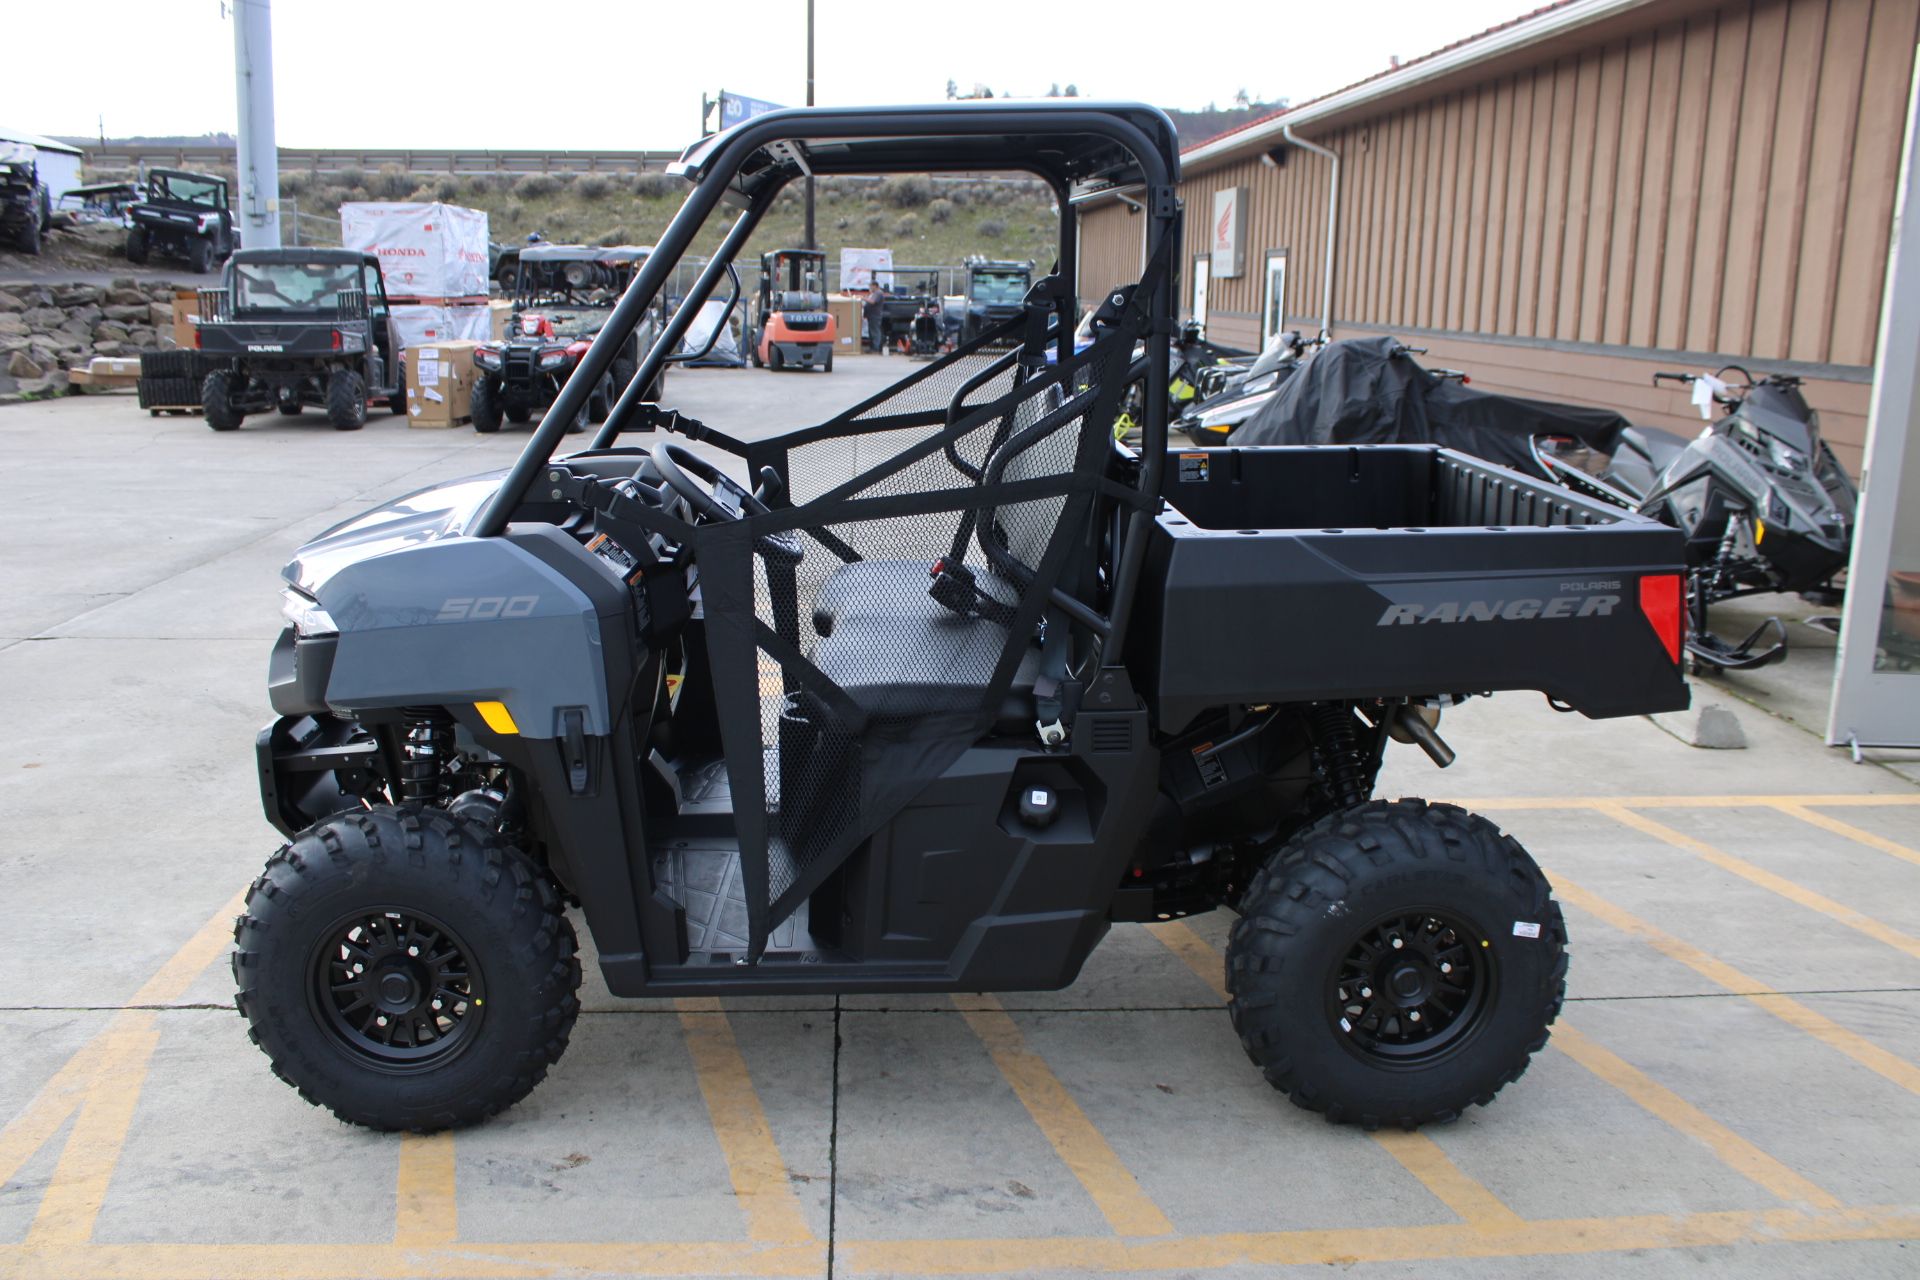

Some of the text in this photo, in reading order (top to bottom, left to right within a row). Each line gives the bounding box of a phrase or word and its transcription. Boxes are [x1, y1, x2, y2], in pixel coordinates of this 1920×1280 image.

[377, 249, 426, 257] HONDA
[1560, 581, 1621, 592] POLARIS
[434, 595, 540, 620] 500
[1376, 595, 1621, 626] RANGER
